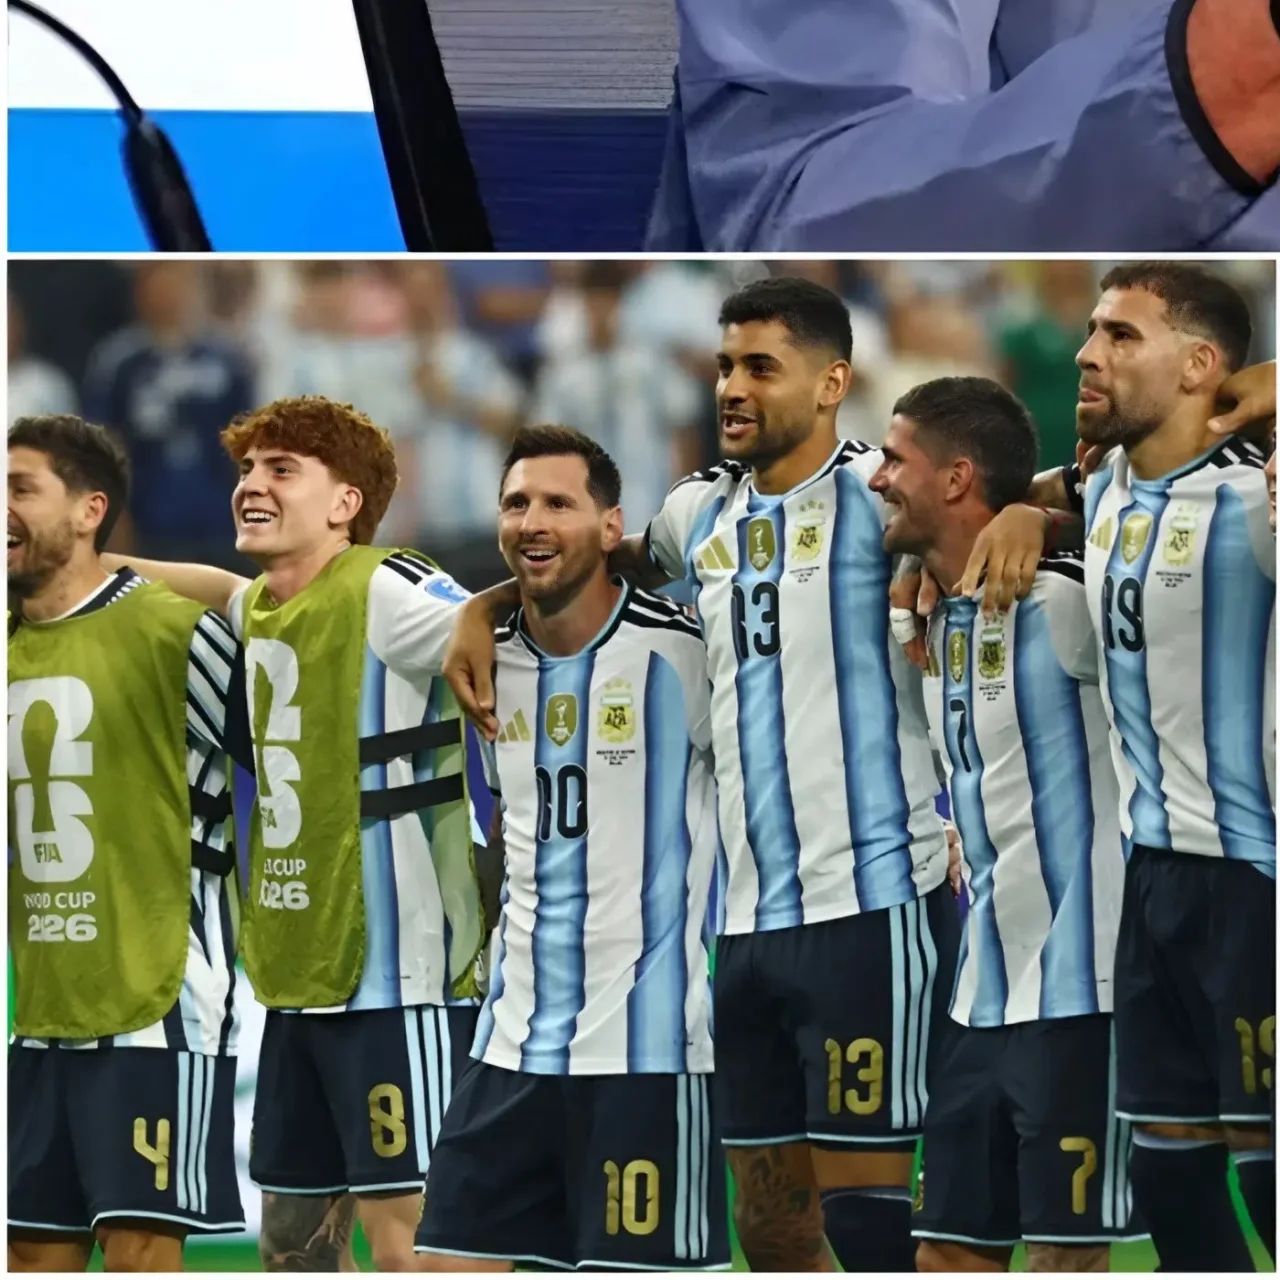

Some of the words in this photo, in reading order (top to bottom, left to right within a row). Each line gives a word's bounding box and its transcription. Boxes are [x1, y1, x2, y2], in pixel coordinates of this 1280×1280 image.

[731, 581, 782, 660] 13
[534, 764, 589, 842] 10
[54, 892, 97, 909] CUP
[824, 1037, 884, 1116] 13
[132, 1117, 171, 1191] 4
[366, 1082, 408, 1158] 8
[604, 1158, 661, 1237] 10
[1059, 1136, 1097, 1215] 7
